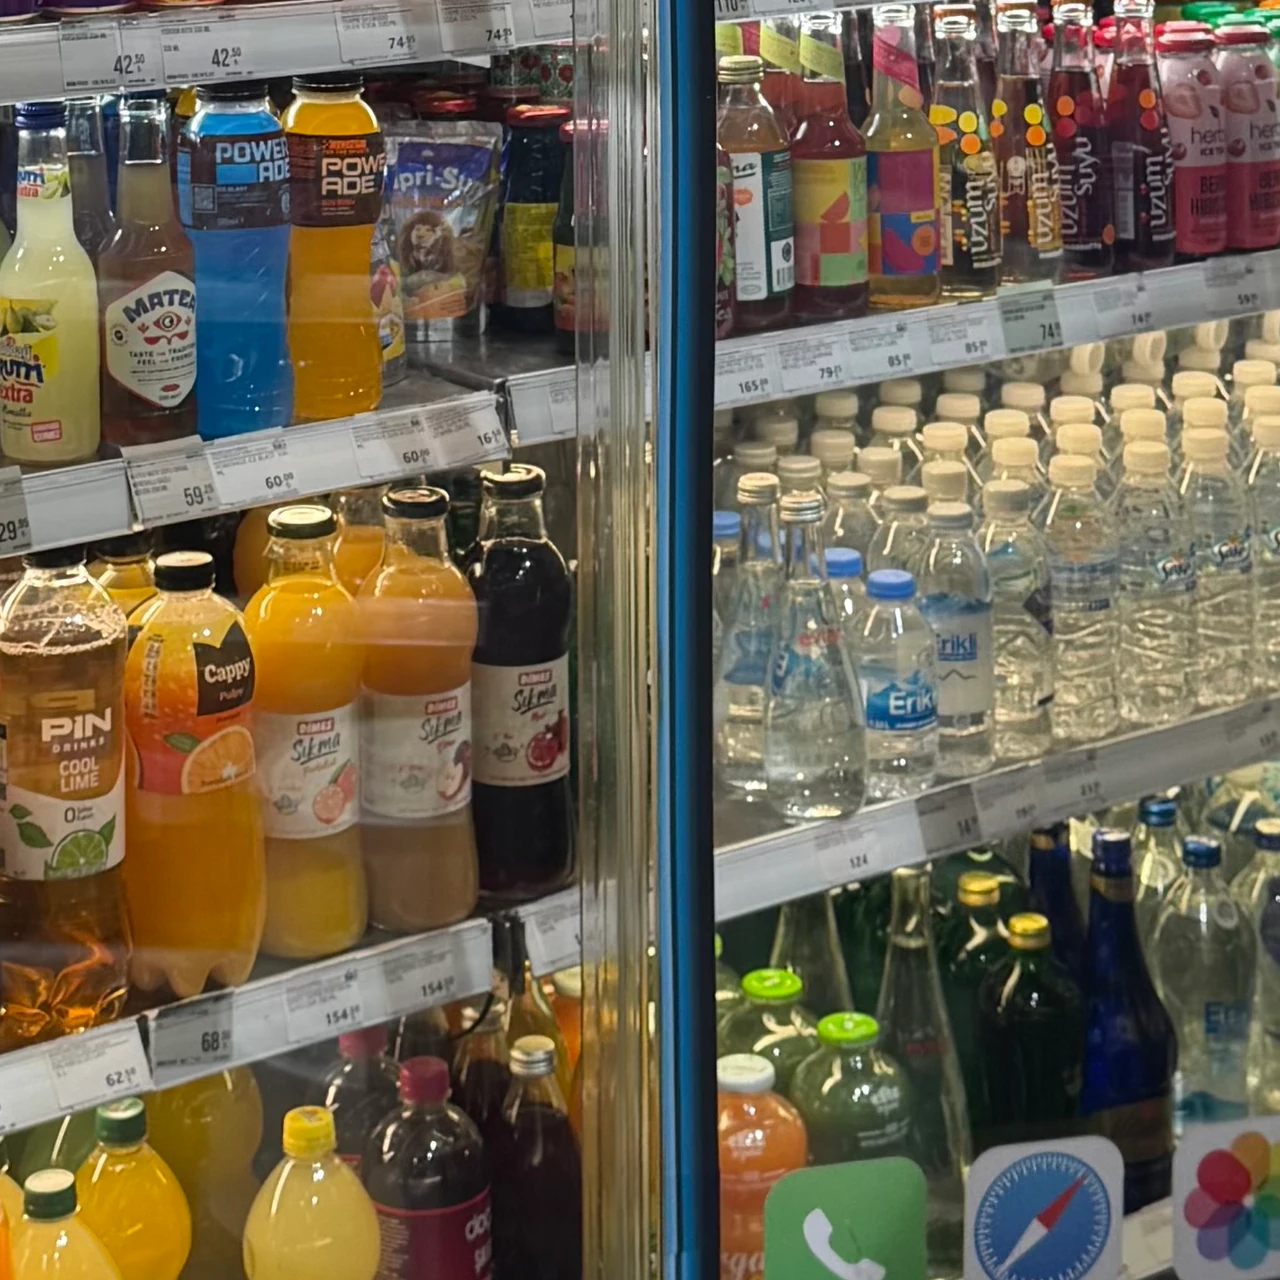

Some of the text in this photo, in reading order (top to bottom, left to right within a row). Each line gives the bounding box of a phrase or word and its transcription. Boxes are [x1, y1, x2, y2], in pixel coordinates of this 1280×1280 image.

[322, 157, 386, 176] POWE
[322, 176, 377, 195] ADE
[204, 655, 251, 685] Cappy
[889, 690, 936, 717] Erik
[41, 707, 112, 742] PIN
[53, 736, 105, 754] DRINKS
[59, 758, 99, 776] COOL
[60, 773, 100, 792] LIME
